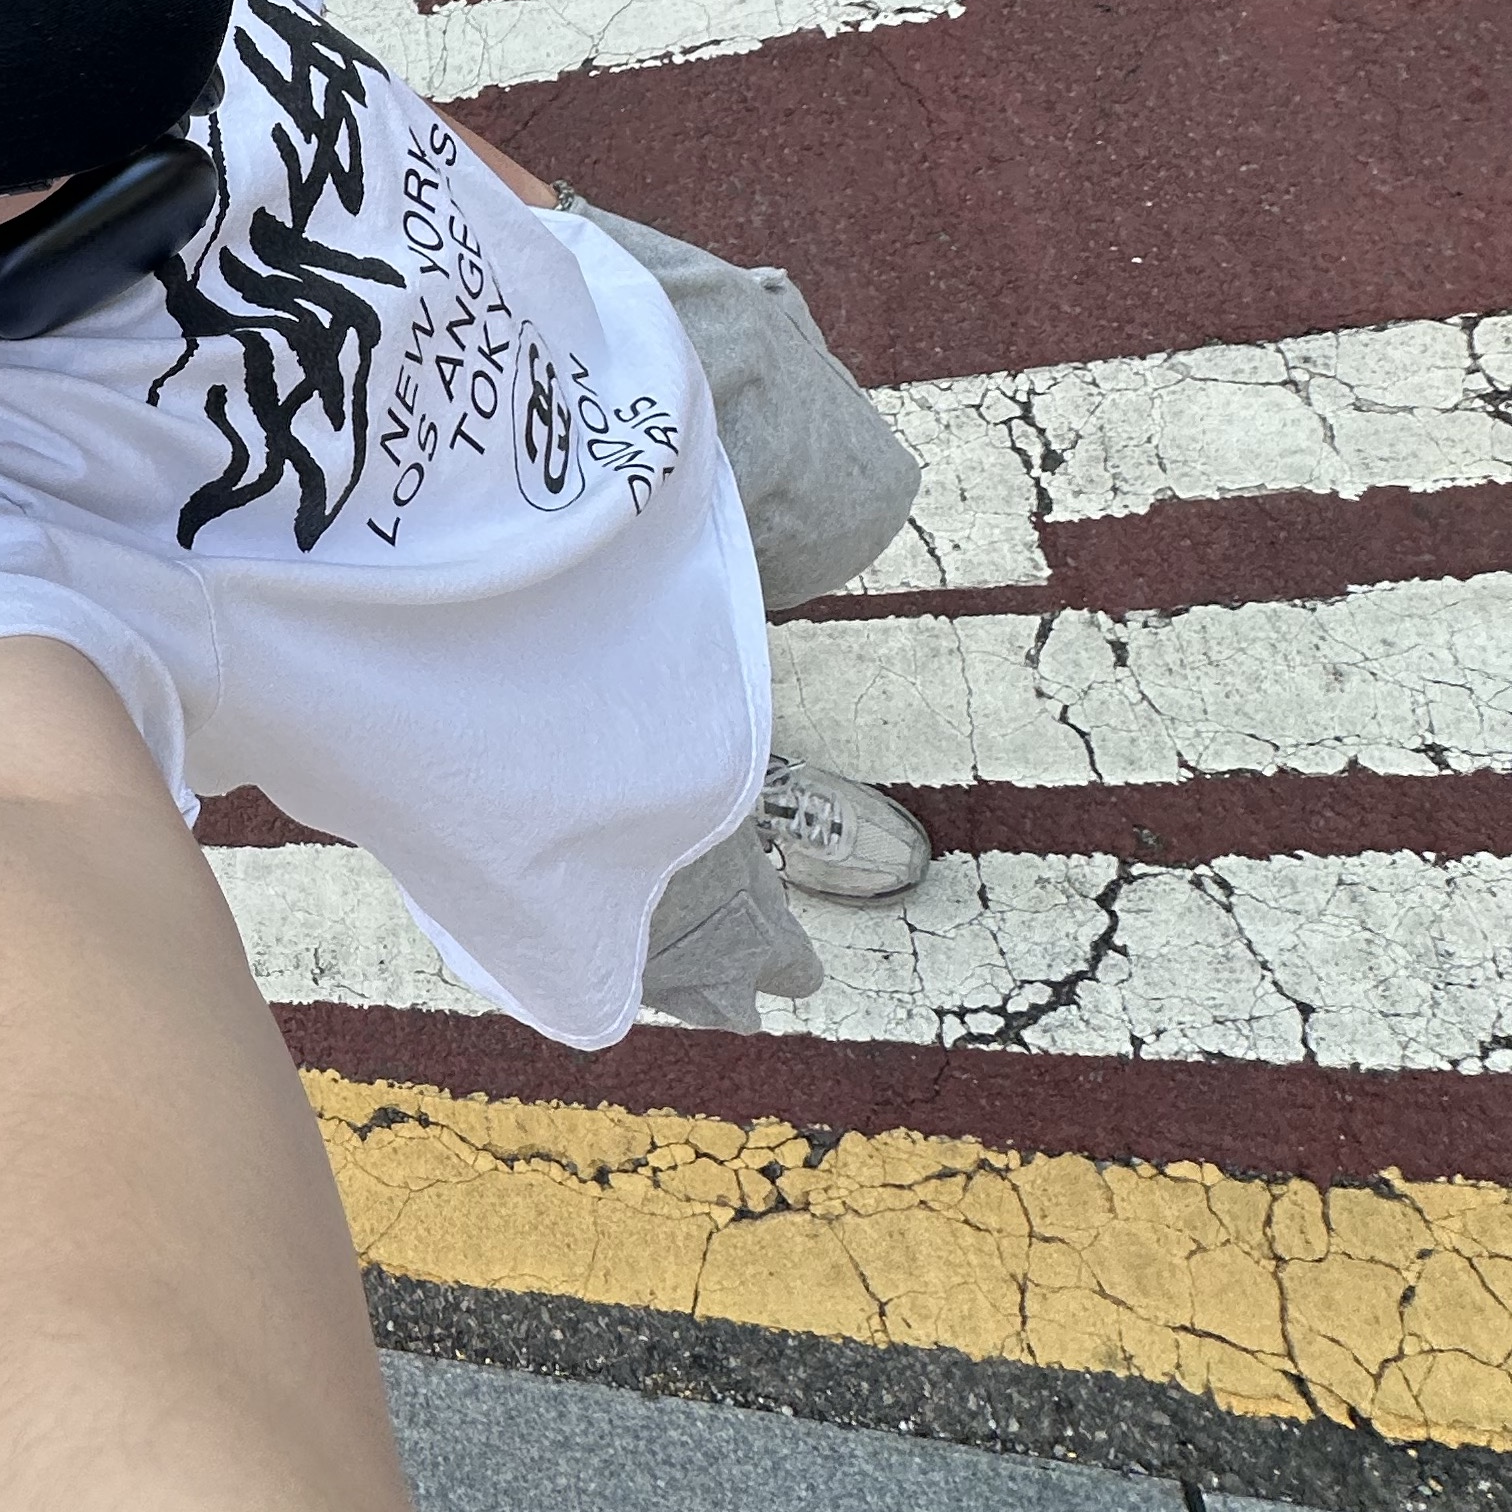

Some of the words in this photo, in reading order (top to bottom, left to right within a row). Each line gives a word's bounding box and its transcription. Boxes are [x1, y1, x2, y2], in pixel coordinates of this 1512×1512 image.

[403, 126, 450, 279] YORK
[367, 421, 438, 547] LOS
[430, 123, 484, 403] ANGES
[380, 296, 435, 467] NEW
[450, 264, 512, 456] TOKY
[569, 352, 655, 516] ONDON
[614, 396, 679, 484] RIS
